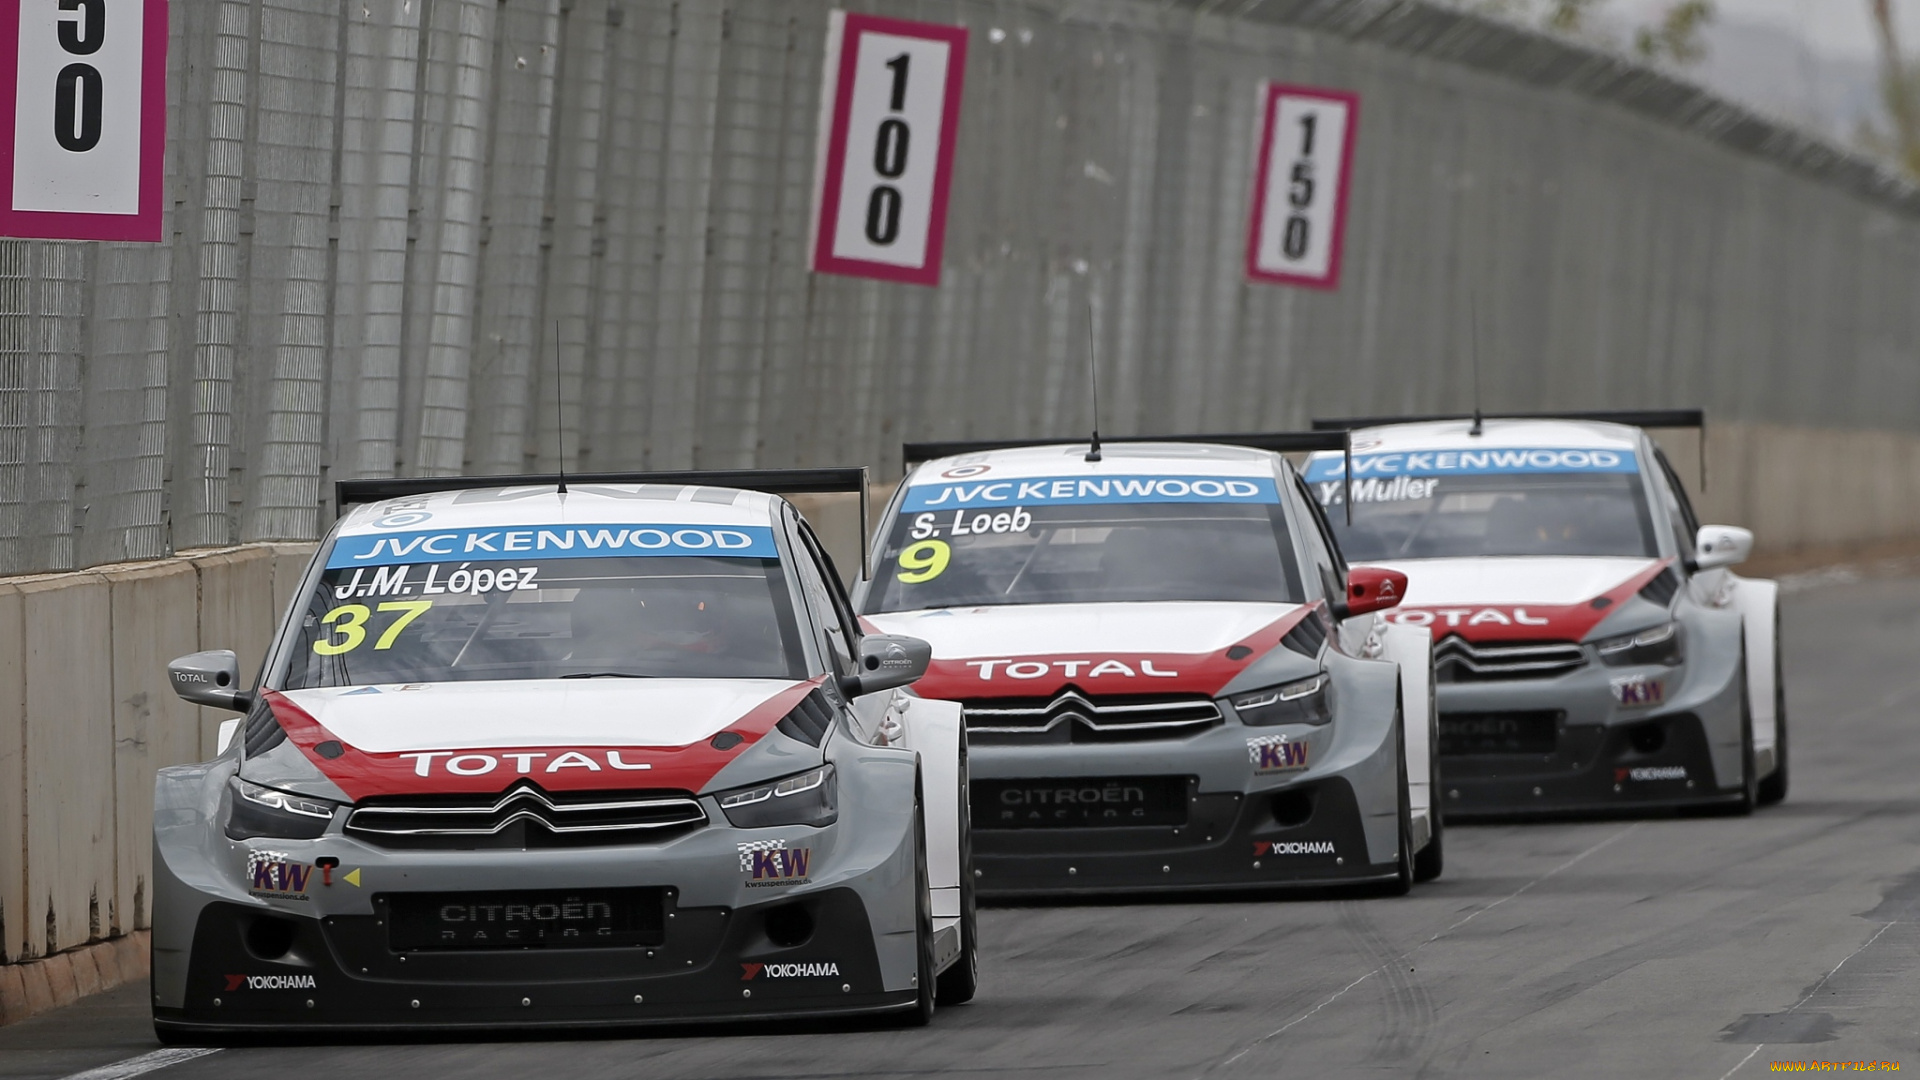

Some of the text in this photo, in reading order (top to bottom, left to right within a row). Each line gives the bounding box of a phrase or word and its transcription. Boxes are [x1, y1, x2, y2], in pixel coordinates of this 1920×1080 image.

[864, 52, 912, 247] 100
[1281, 112, 1318, 261] 150
[1319, 474, 1439, 506] Y. Muller
[911, 506, 1032, 540] S. Loeb
[896, 539, 951, 584] 9
[335, 562, 539, 600] J.M. López
[312, 600, 433, 656] 37
[174, 671, 208, 684] TOTAL
[967, 658, 1178, 681] TOTAL
[398, 751, 652, 778] TOTAL
[1259, 741, 1309, 770] KW
[1272, 840, 1335, 855] YOKOHAMA
[253, 860, 314, 893] KW
[752, 848, 811, 880] KW
[246, 974, 316, 990] YOKOHAMA
[763, 962, 839, 978] YOKOHAMA
